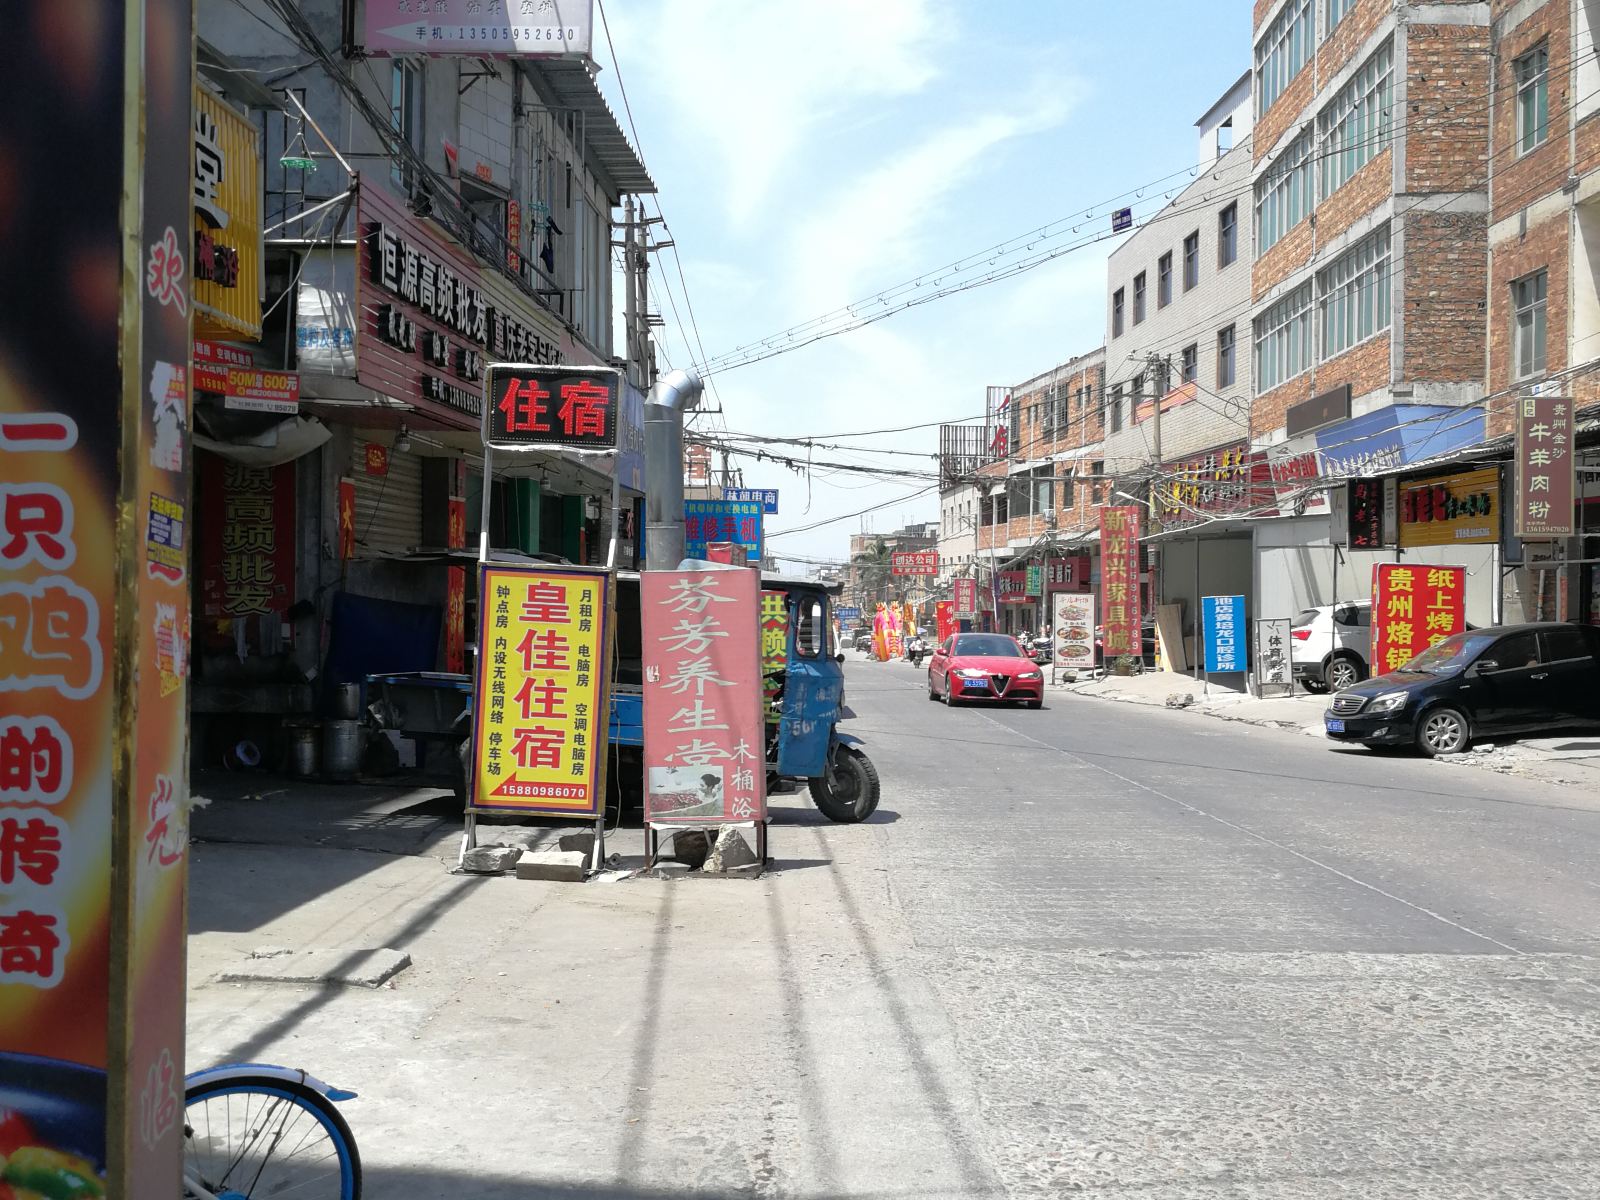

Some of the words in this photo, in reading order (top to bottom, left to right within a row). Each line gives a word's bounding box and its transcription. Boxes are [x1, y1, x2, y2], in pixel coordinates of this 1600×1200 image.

[379, 222, 487, 345] 恒源高频批发
[499, 378, 609, 437] 住宿
[1552, 404, 1567, 459] 贵州金沙
[1529, 422, 1552, 519] 牛羊肉粉
[495, 585, 510, 629] 钟点房
[578, 589, 592, 632] 月租房
[1104, 510, 1130, 650] 新龙兴家具城
[1386, 568, 1415, 671] 贵州烙锅
[490, 636, 507, 725] 内设无线网络
[510, 581, 571, 769] 皇佳住宿
[576, 644, 590, 687] 电脑房
[659, 576, 738, 767] 芬芳养生堂
[1268, 635, 1284, 683] 体育彩票
[488, 732, 502, 775] 停车场
[571, 703, 587, 776] 空调电脑房
[502, 784, 585, 798] 15880986070
[730, 738, 758, 818] 木桶浴
